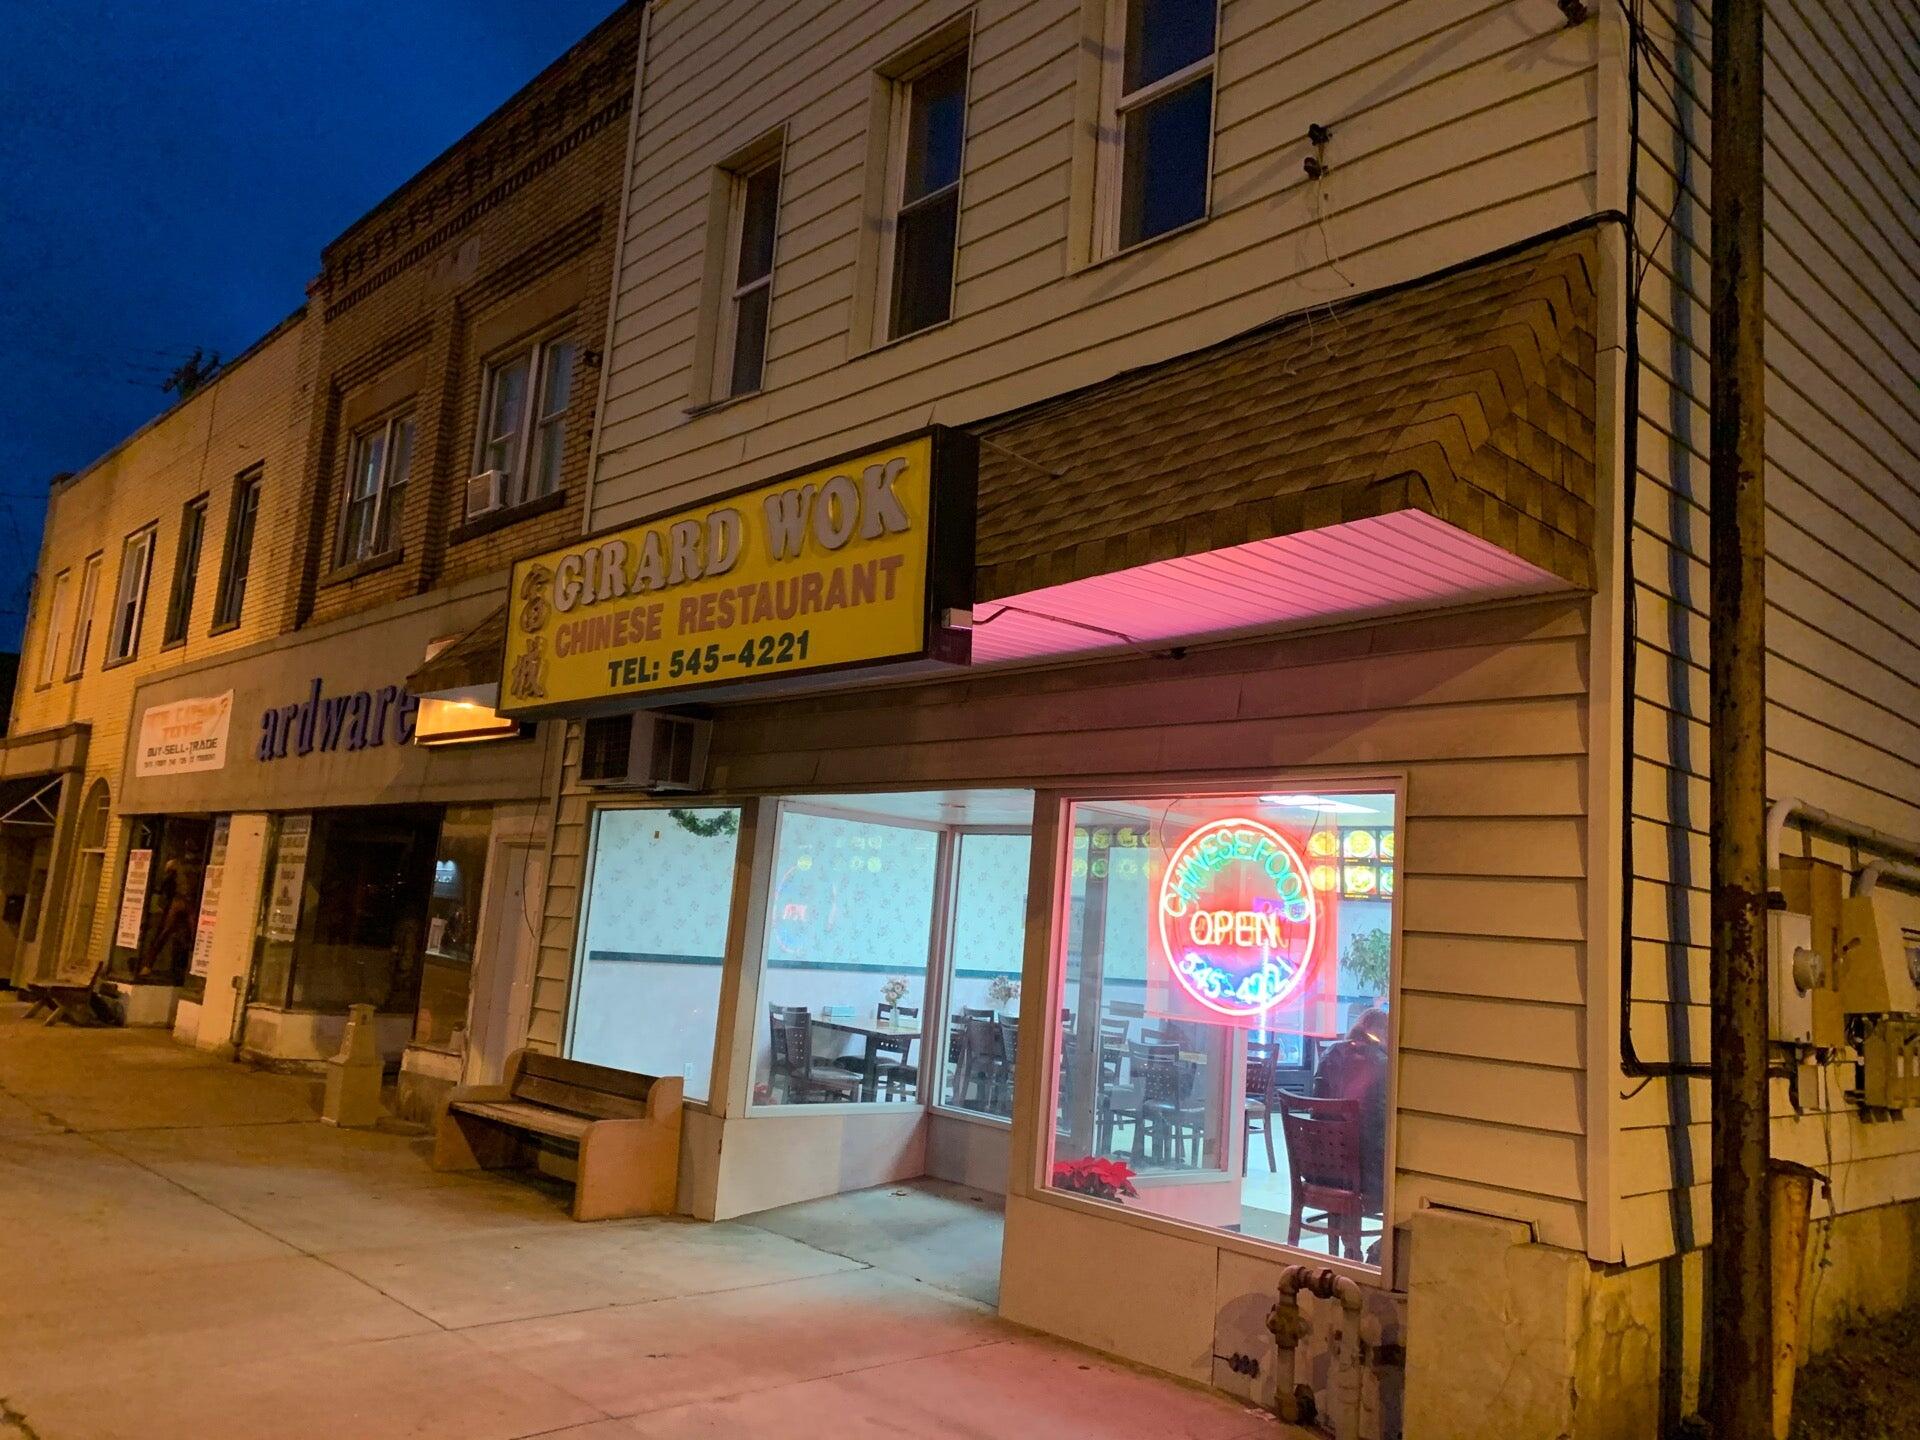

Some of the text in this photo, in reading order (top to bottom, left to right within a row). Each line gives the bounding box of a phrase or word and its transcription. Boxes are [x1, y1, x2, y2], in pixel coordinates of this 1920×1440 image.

[553, 457, 911, 613] GIRARD WOK
[554, 555, 904, 659] CHINESE RESTAURANT
[608, 629, 810, 688] TEL: 545-4221
[256, 677, 421, 763] ardware
[1163, 829, 1310, 923] CHINESE FOOD
[1189, 910, 1279, 949] OPEN
